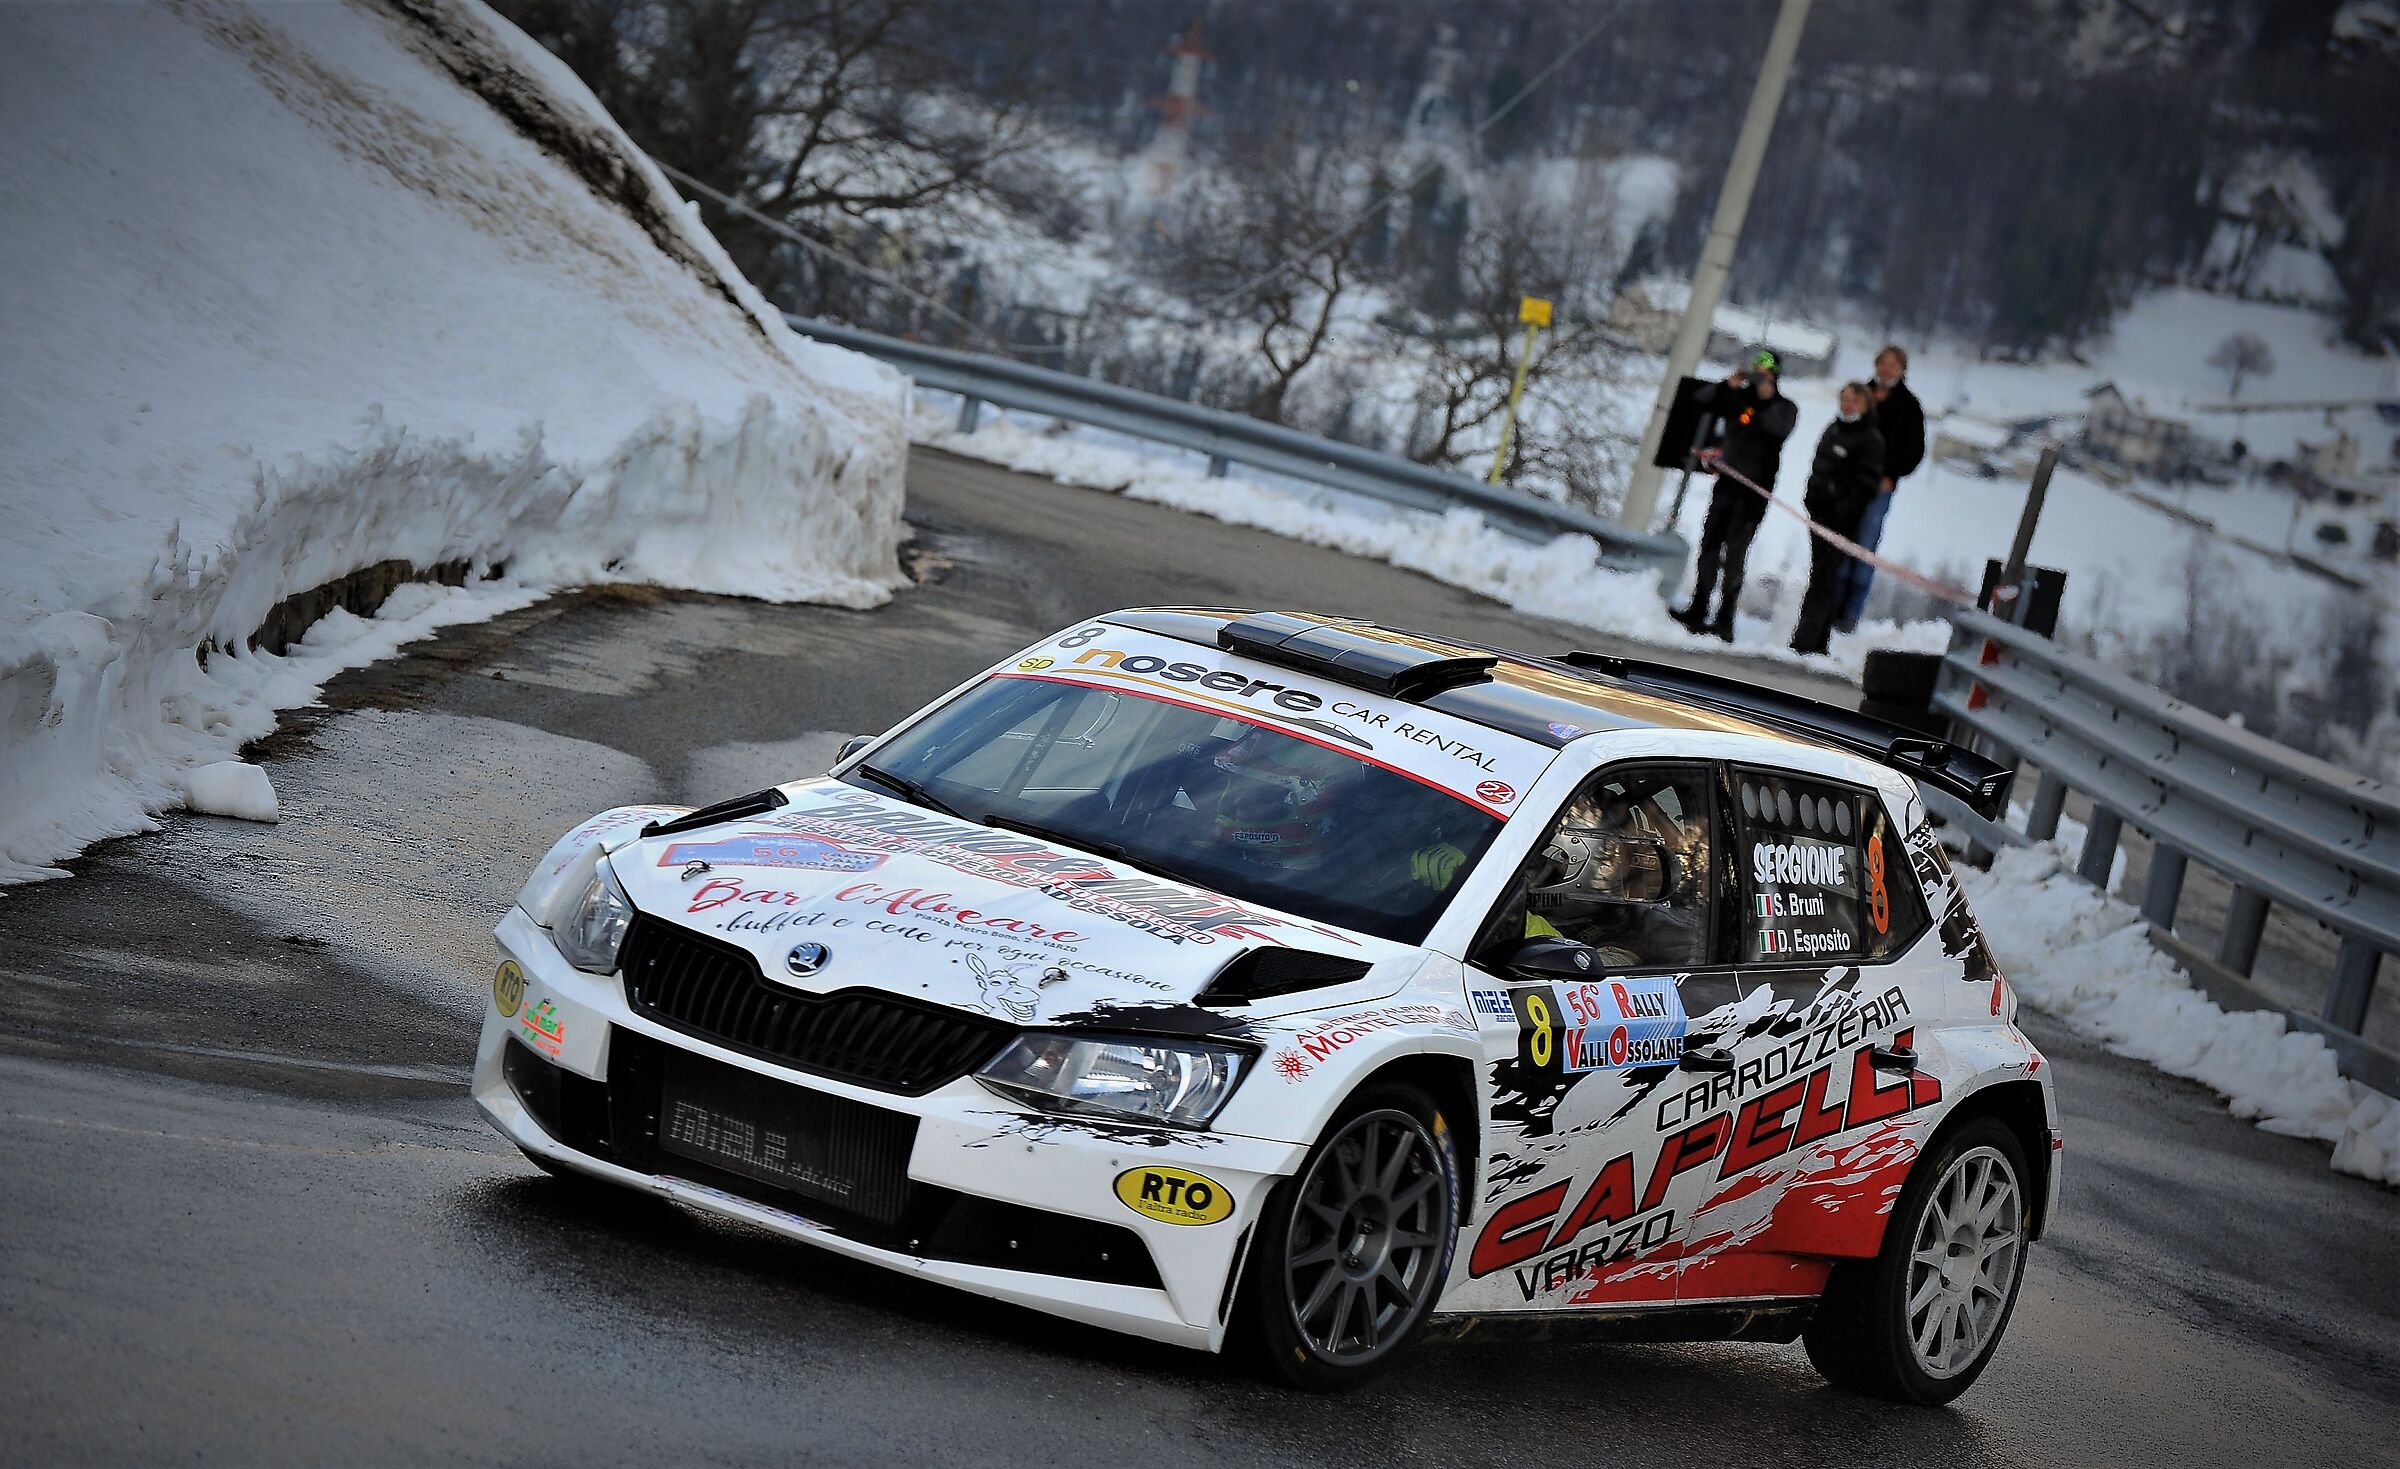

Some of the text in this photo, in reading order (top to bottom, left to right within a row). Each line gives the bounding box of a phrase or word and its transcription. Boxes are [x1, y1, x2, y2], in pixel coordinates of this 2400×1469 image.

[1059, 628, 1106, 648] 8
[1019, 658, 1054, 669] SD
[1072, 648, 1496, 773] nosere CAR RENTAL
[1476, 781, 1515, 802] 24
[790, 803, 1048, 854] BRUNO
[1753, 842, 1845, 886] SERGIONE
[1868, 836, 1889, 935] 8
[688, 877, 808, 912] Bar
[919, 850, 1187, 945] CREVOLADOSSOLA
[1023, 870, 1216, 945] AUTOLAVAGGIO
[1773, 892, 1825, 917] S. Bruni
[832, 917, 854, 928] e
[866, 919, 937, 943] cene
[945, 938, 991, 951] per
[997, 944, 1051, 961] ogni
[1058, 956, 1175, 992] occasione
[953, 922, 989, 936] Pietro
[1043, 940, 1078, 953] VARZO
[1777, 928, 1851, 957] D. Esposito
[1611, 982, 1669, 1019] RALLY
[1295, 1010, 1379, 1044] ALBERGO
[1301, 1017, 1399, 1063] MONTE
[1526, 994, 1552, 1067] 8
[1656, 985, 1912, 1132] CARROZZERIA
[1468, 1025, 1942, 1280] CAPELLI
[1138, 1199, 1207, 1221] l'altra radio
[1140, 1172, 1213, 1211] RTO
[1514, 1208, 1676, 1302] VARZO
